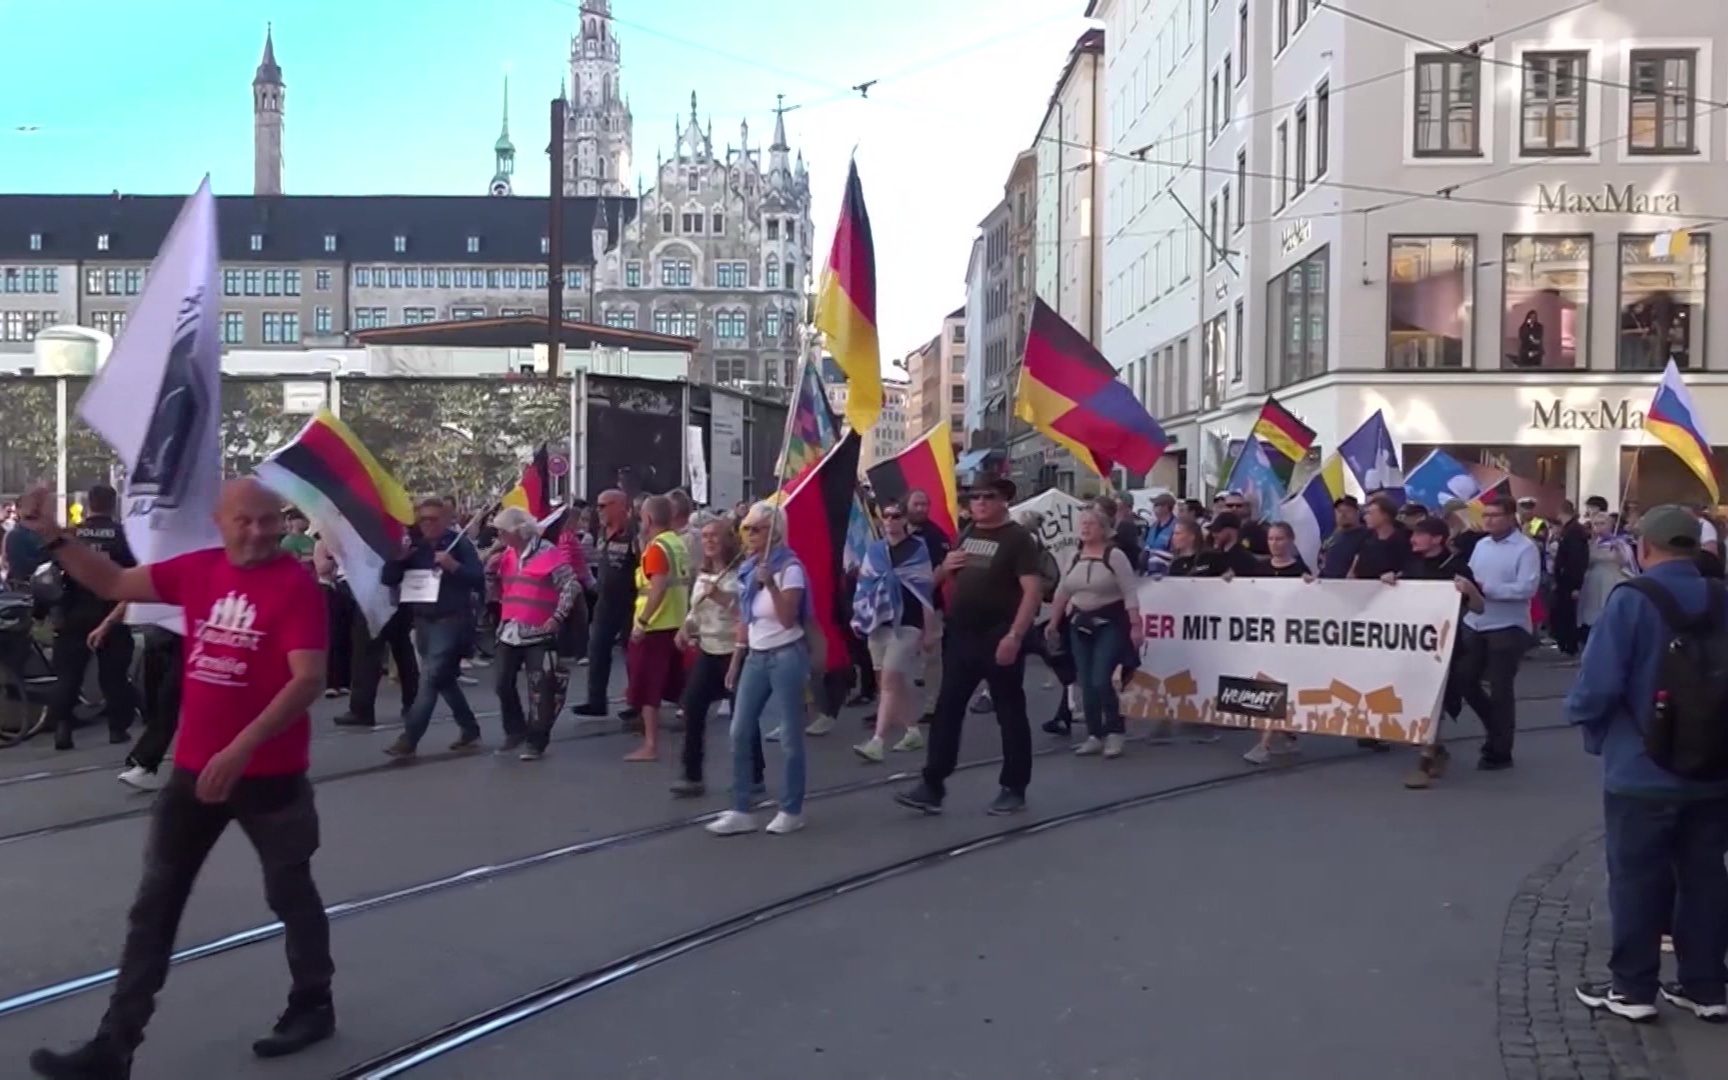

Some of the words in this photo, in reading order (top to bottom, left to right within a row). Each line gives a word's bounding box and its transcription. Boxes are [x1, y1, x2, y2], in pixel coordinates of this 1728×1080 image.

[1536, 182, 1681, 214] MaxMara
[1182, 615, 1222, 641] MIT
[1229, 617, 1275, 643] DER
